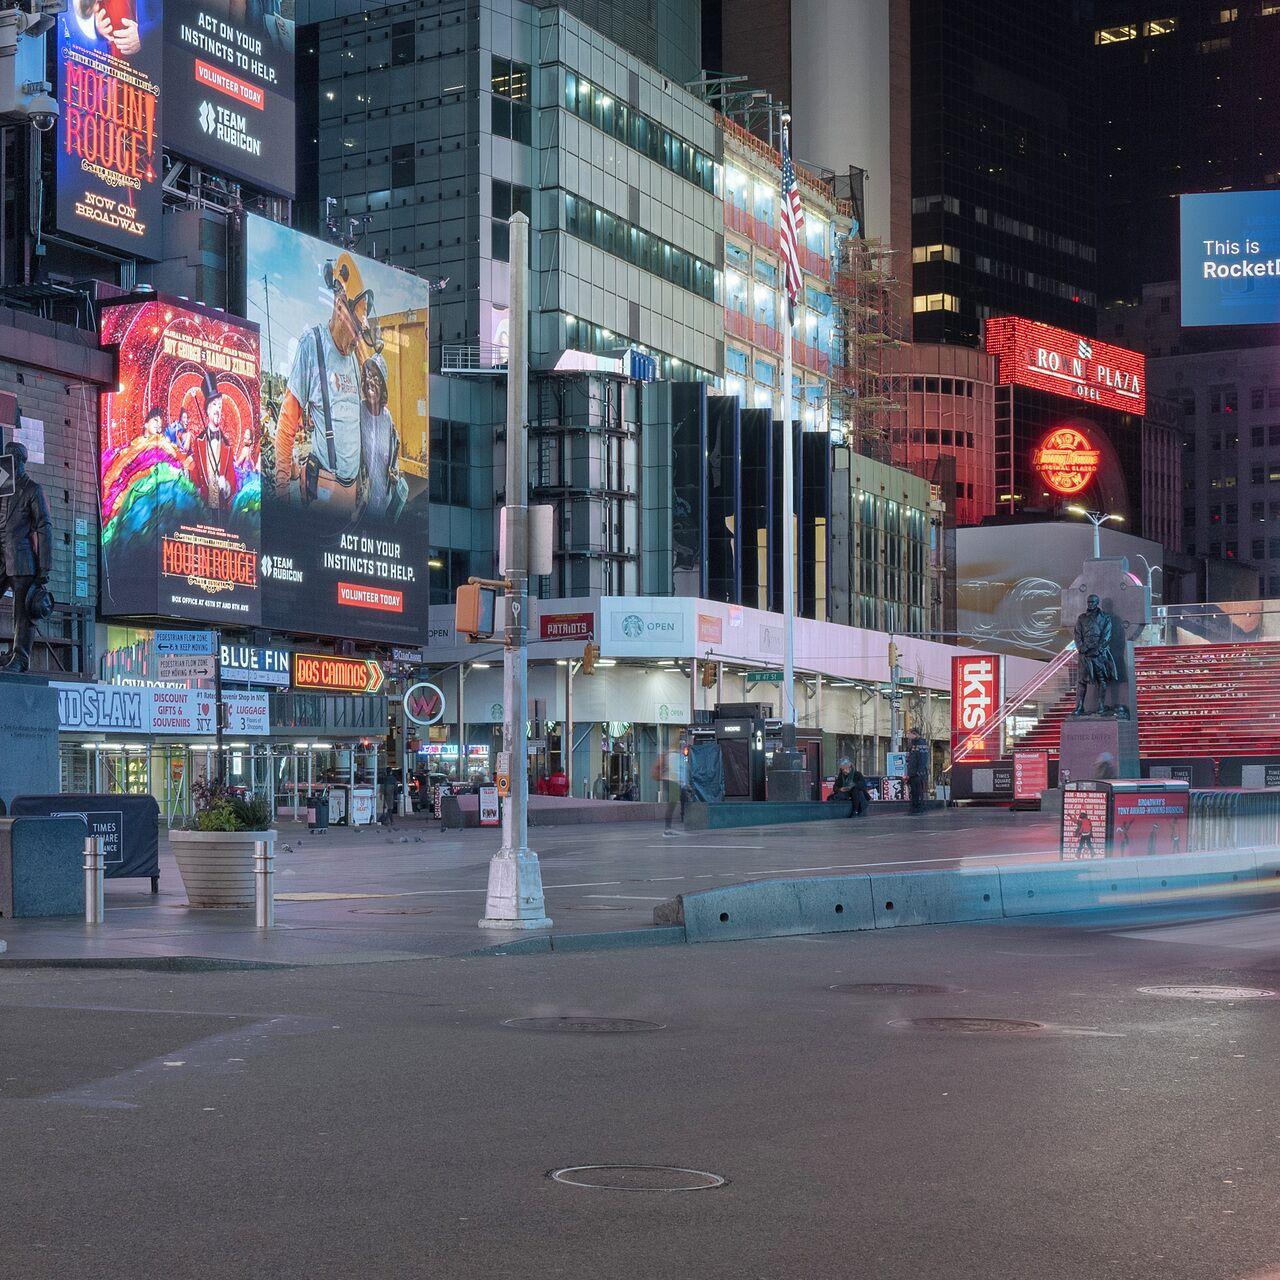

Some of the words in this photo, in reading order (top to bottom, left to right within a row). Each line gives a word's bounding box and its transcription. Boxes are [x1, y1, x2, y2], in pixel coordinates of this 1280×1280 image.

[198, 11, 218, 34] ACT
[219, 22, 234, 42] ON
[236, 29, 262, 56] YOUR
[180, 24, 234, 63] INSTINCTS
[236, 51, 249, 71] TO
[251, 58, 278, 85] HELP.
[198, 65, 239, 94] VOLUNTEER
[239, 84, 261, 104] TODAY
[65, 60, 143, 134] MOULIN
[217, 105, 246, 133] TEAM
[217, 122, 262, 156] RUBICON
[84, 191, 116, 212] NOW
[117, 202, 137, 219] ON
[75, 202, 145, 235] BROADWAY
[1202, 239, 1238, 256] This
[1245, 237, 1260, 254] is
[1097, 364, 1140, 394] PLAZA
[1051, 432, 1083, 447] HOT
[340, 533, 358, 550] ACT
[360, 537, 373, 553] ON
[376, 539, 401, 559] YOUR
[162, 539, 210, 577] MOULIN
[211, 543, 257, 586] ROUGE!
[272, 555, 293, 569] TEAM
[323, 552, 374, 576] INSTINCTS
[376, 560, 388, 577] TO
[390, 563, 415, 583] HELP.
[272, 566, 303, 583] RUBICON
[171, 595, 181, 603] BOX
[182, 596, 198, 605] OFFICE
[340, 587, 379, 603] VOLUNTEER
[380, 593, 401, 606] TODAY
[547, 623, 587, 635] PATRIOTS
[647, 623, 675, 631] OPEN
[157, 633, 183, 641] PEDESTRIAN
[196, 634, 208, 642] ZONE
[190, 643, 208, 652] MOVING
[160, 660, 184, 668] PEDESTRIAN
[185, 659, 197, 667] FLOW
[197, 658, 208, 666] ZONE
[220, 645, 260, 669] BLUE
[264, 649, 289, 671] FIN
[171, 668, 188, 676] MOVING
[297, 662, 320, 683] DOS
[321, 664, 367, 687] CAMINOS
[154, 693, 188, 704] DISCOUNT
[196, 692, 203, 700] #1
[238, 694, 250, 702] Shop
[256, 694, 265, 702] NYC
[963, 660, 993, 729] tkts
[157, 705, 177, 716] GIFTS
[177, 705, 183, 715] &
[236, 705, 267, 715] LUGGAGE
[408, 696, 438, 715] W
[670, 709, 684, 717] OPEN
[152, 718, 191, 728] SOUVENIRS
[196, 718, 211, 731] NY
[240, 717, 246, 731] 3
[93, 823, 116, 832] TIMES
